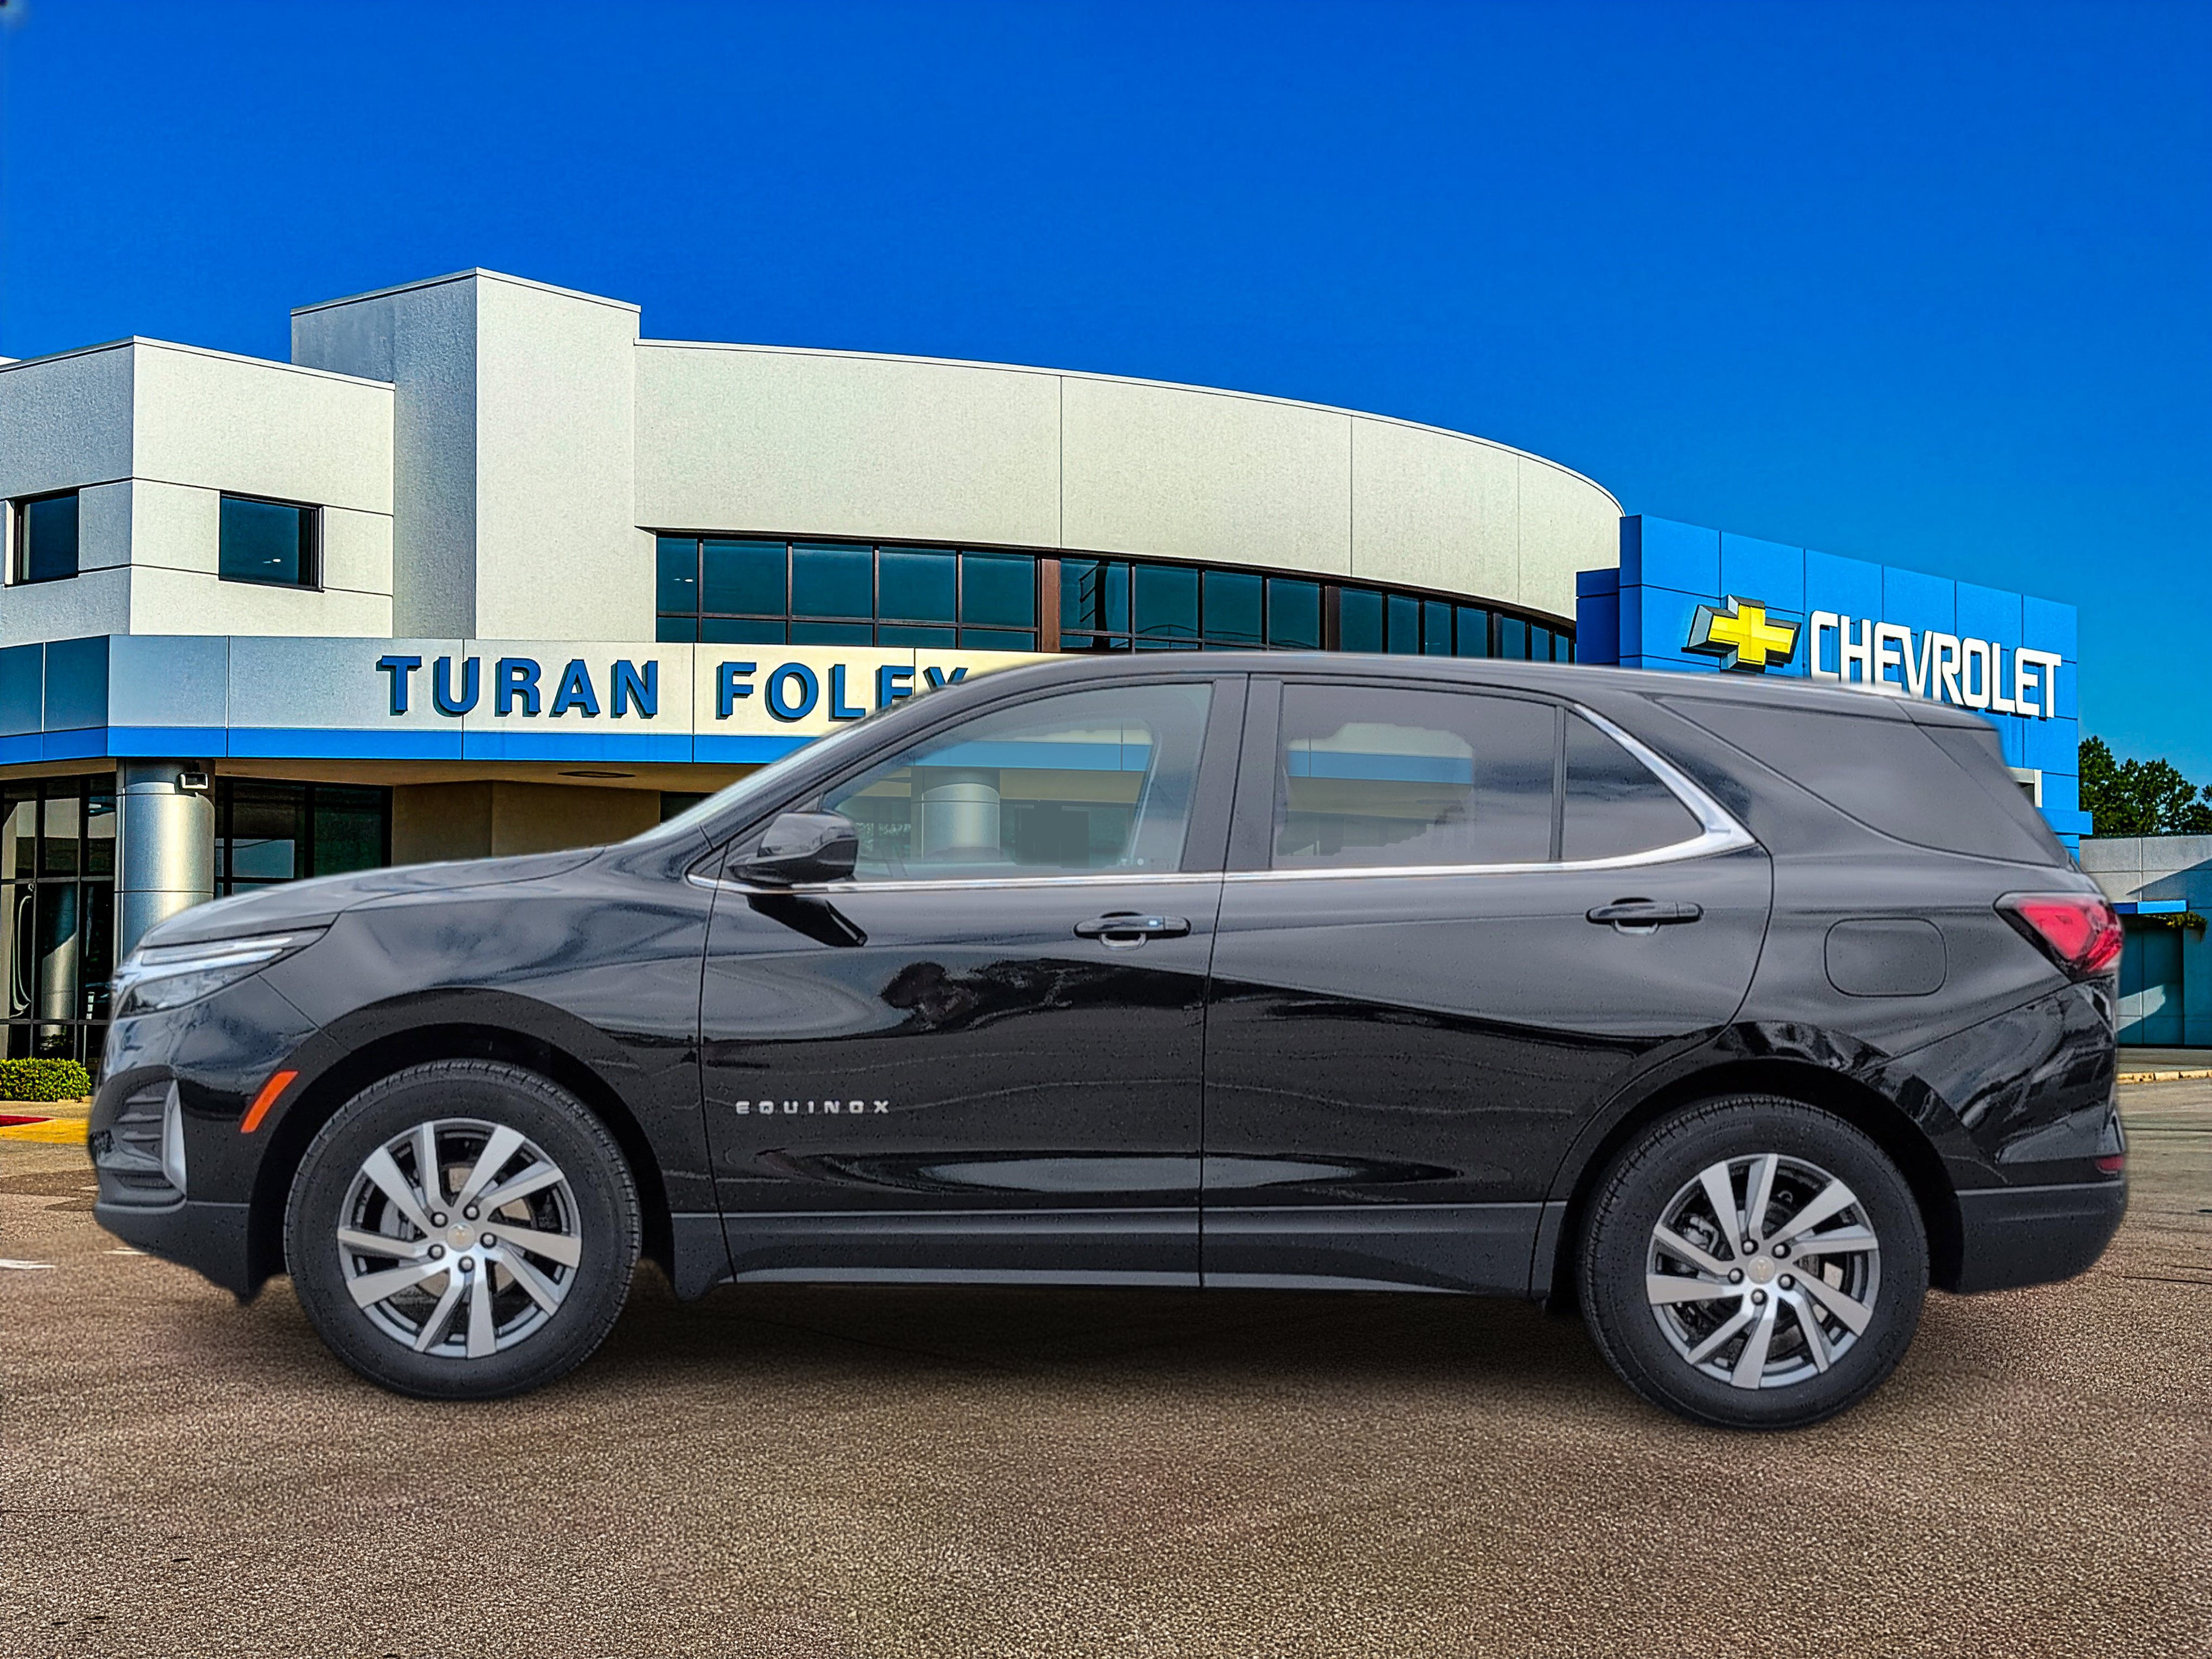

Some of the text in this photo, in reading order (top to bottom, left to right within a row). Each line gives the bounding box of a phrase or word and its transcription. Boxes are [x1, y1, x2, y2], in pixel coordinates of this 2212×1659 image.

[376, 655, 659, 719] TURAN
[1810, 610, 2062, 718] CHEVROLET
[735, 1099, 890, 1115] EQUINOX
